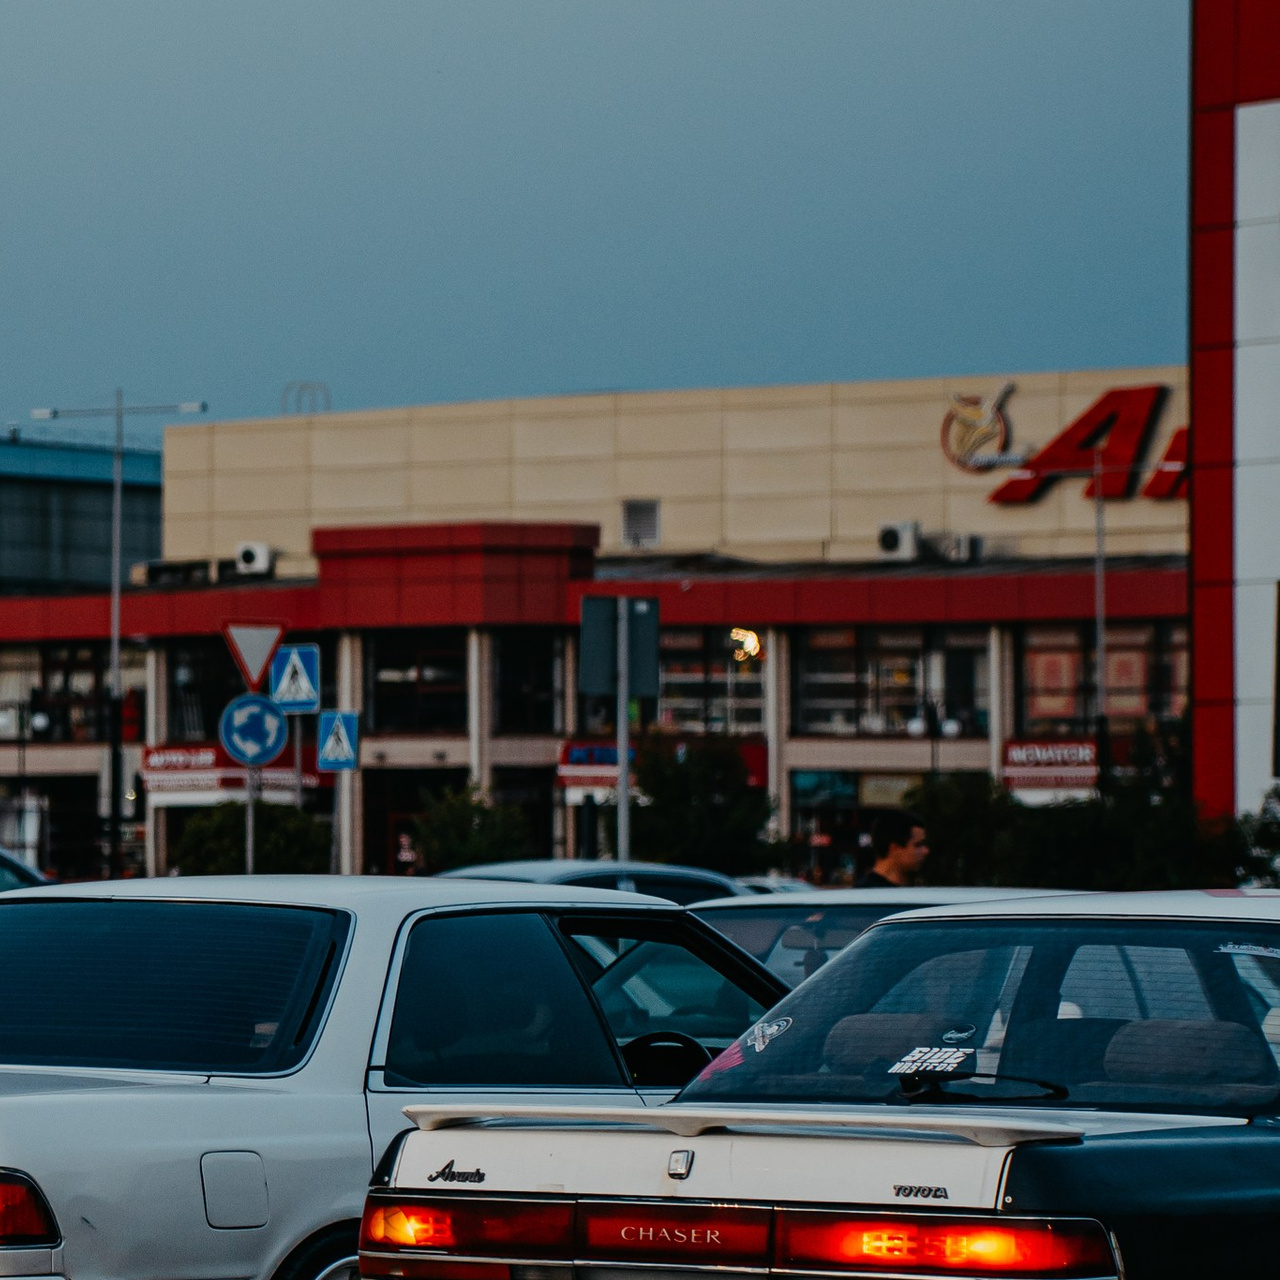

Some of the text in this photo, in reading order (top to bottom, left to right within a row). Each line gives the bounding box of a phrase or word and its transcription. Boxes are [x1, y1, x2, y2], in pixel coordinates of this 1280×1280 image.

[900, 1047, 975, 1064] SIDE
[893, 1184, 949, 1200] TOYOTA
[621, 1226, 721, 1244] CHASER
